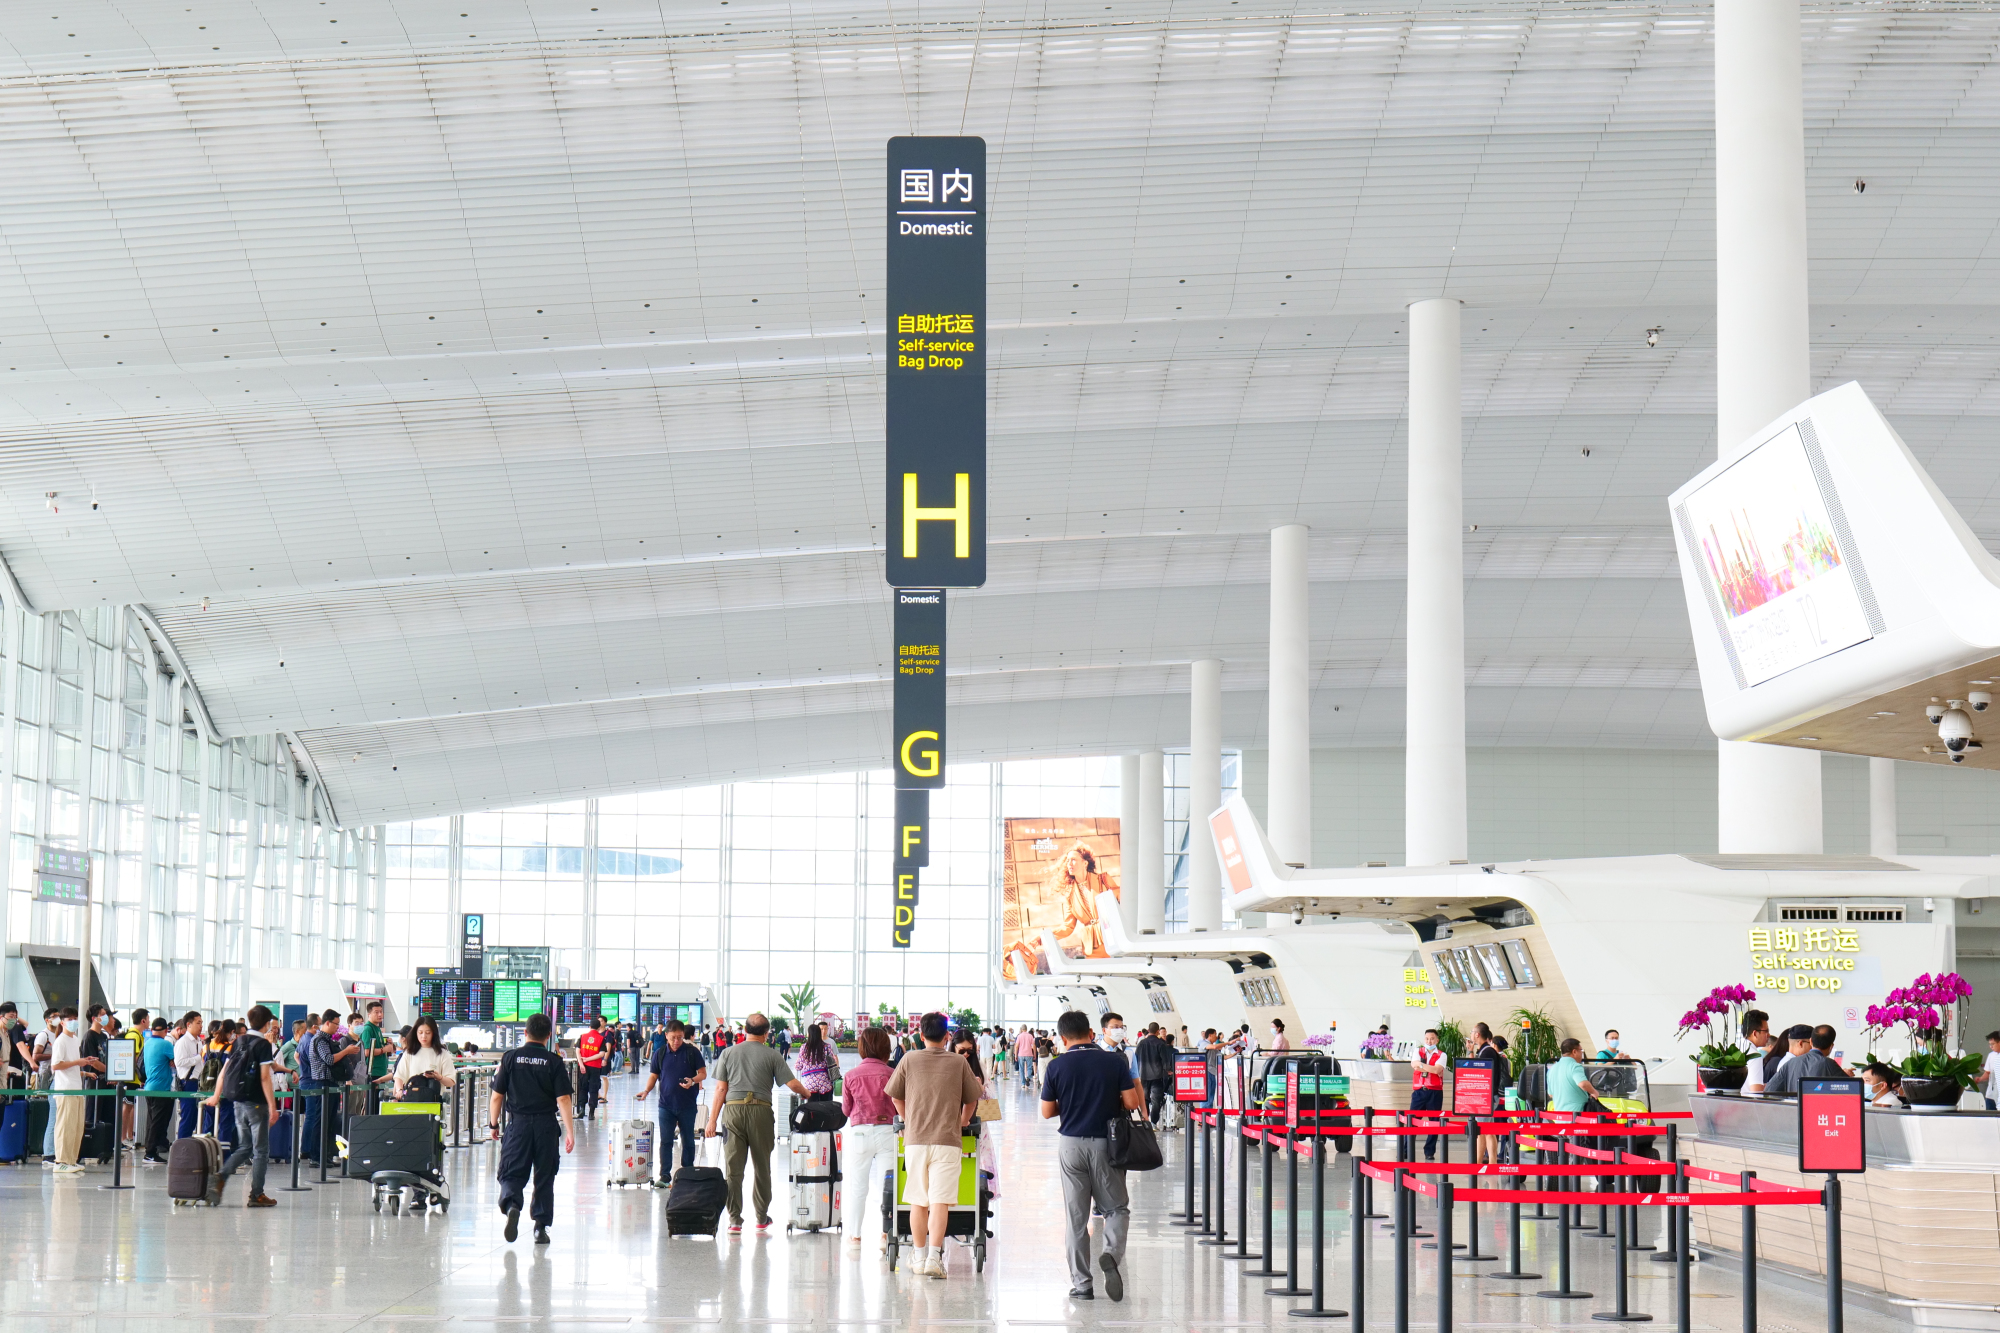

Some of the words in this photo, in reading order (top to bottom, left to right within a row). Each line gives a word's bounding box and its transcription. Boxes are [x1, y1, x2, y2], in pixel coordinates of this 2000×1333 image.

[901, 168, 973, 203] 国内
[900, 221, 973, 236] Domestic
[898, 314, 974, 333] 自助托运
[898, 339, 975, 352] Self-service
[898, 355, 925, 370] Bag
[929, 355, 964, 370] Drop
[903, 472, 970, 558] H
[900, 595, 940, 604] Domestic
[899, 645, 940, 656] 自助托运
[899, 658, 940, 666] Self-service
[899, 667, 914, 675] Bag
[915, 667, 934, 675] Drop
[900, 730, 939, 777] G
[902, 825, 921, 857] F
[898, 874, 914, 899] E
[895, 905, 913, 926] D
[1748, 926, 1860, 952] 自助托运
[1752, 953, 1855, 971] Self-service
[1403, 968, 1430, 982] 自助
[1753, 972, 1790, 993] Bag
[1794, 973, 1842, 993] Drop
[1404, 984, 1434, 994] Self-s
[1405, 996, 1427, 1009] Bag
[516, 1056, 548, 1066] SECURITY
[1817, 1114, 1846, 1126] 出口
